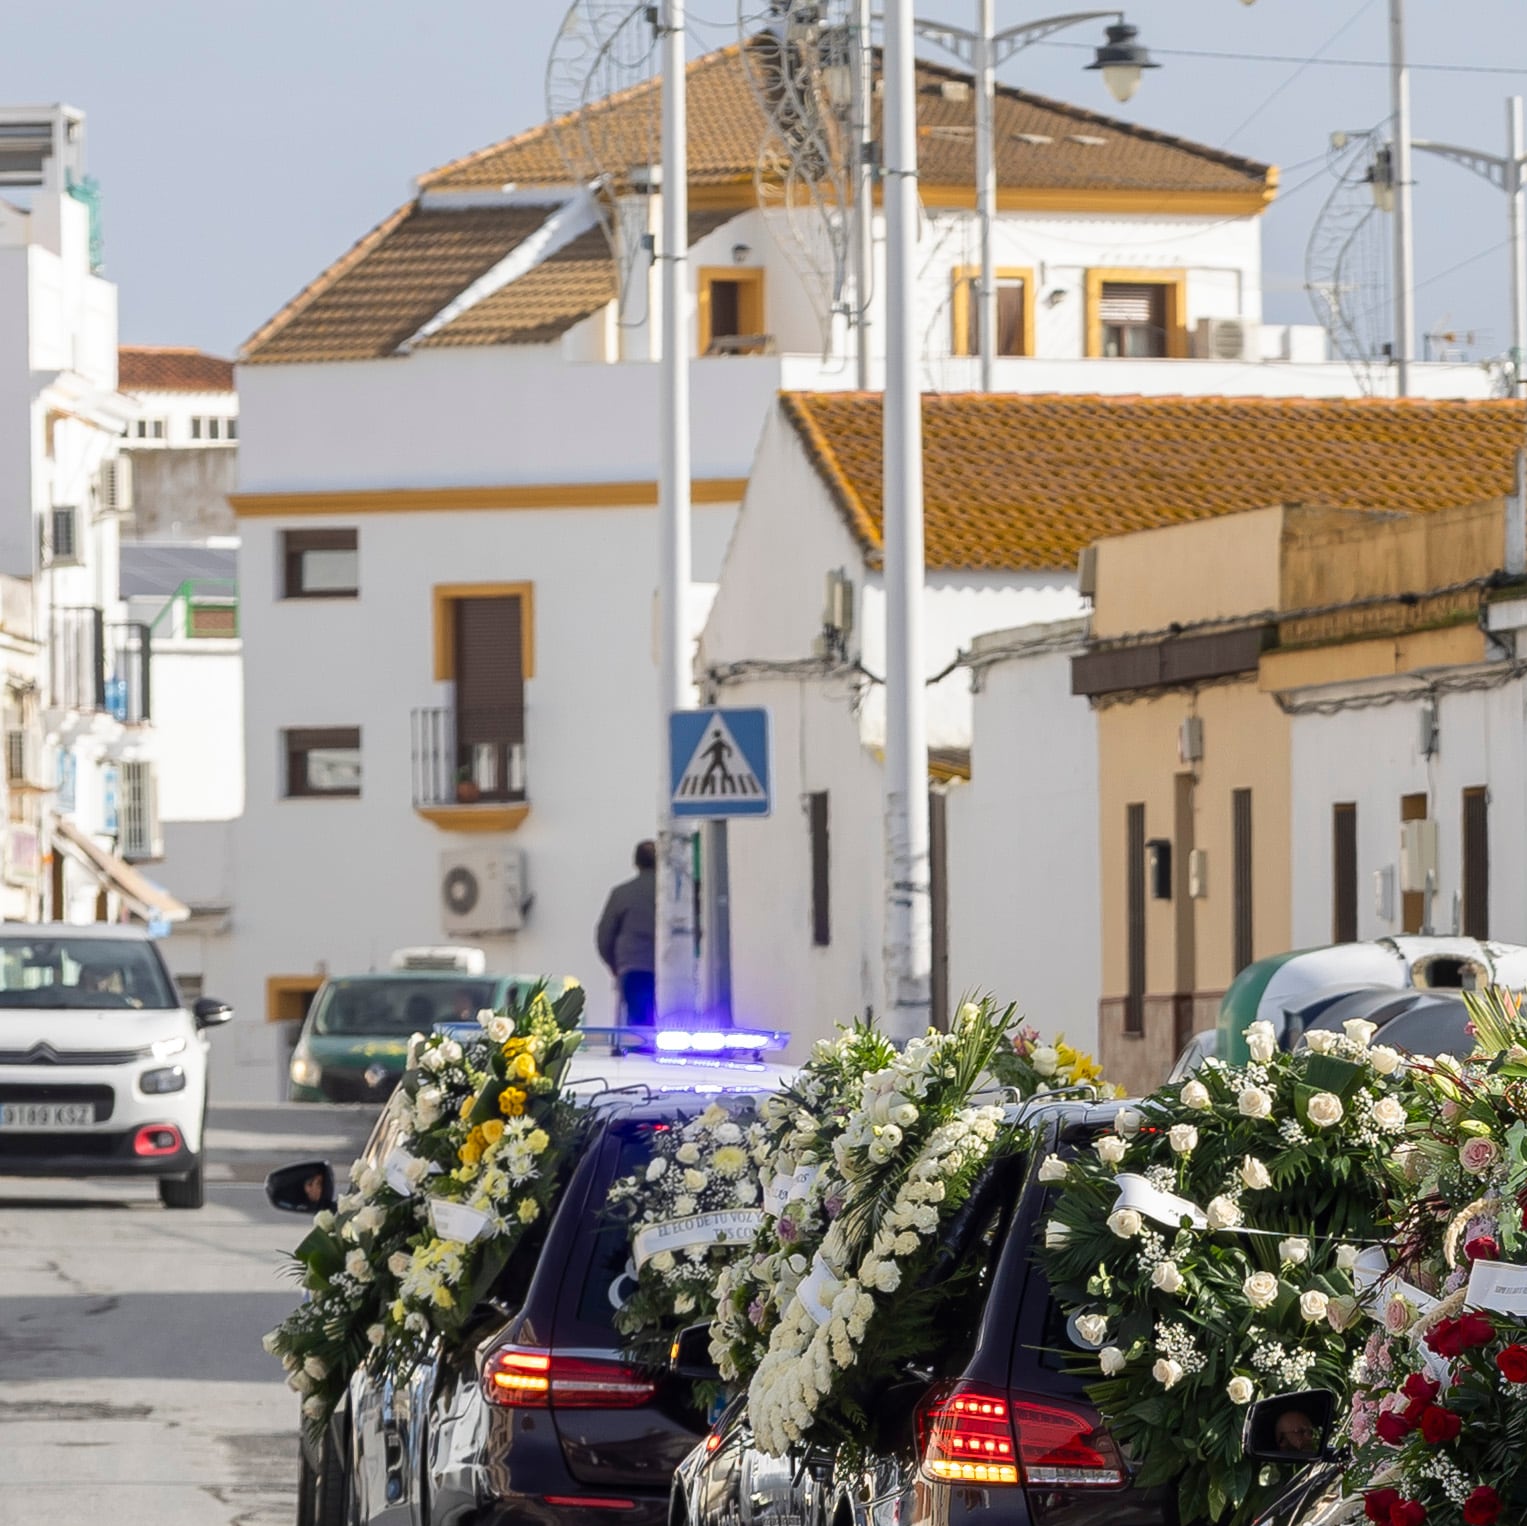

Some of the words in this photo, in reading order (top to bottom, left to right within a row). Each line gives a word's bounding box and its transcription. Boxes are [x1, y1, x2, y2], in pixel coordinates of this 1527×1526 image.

[672, 1219, 694, 1234] ECO
[696, 1215, 713, 1229] DE
[712, 1212, 728, 1225] TU
[730, 1211, 753, 1224] VOZ
